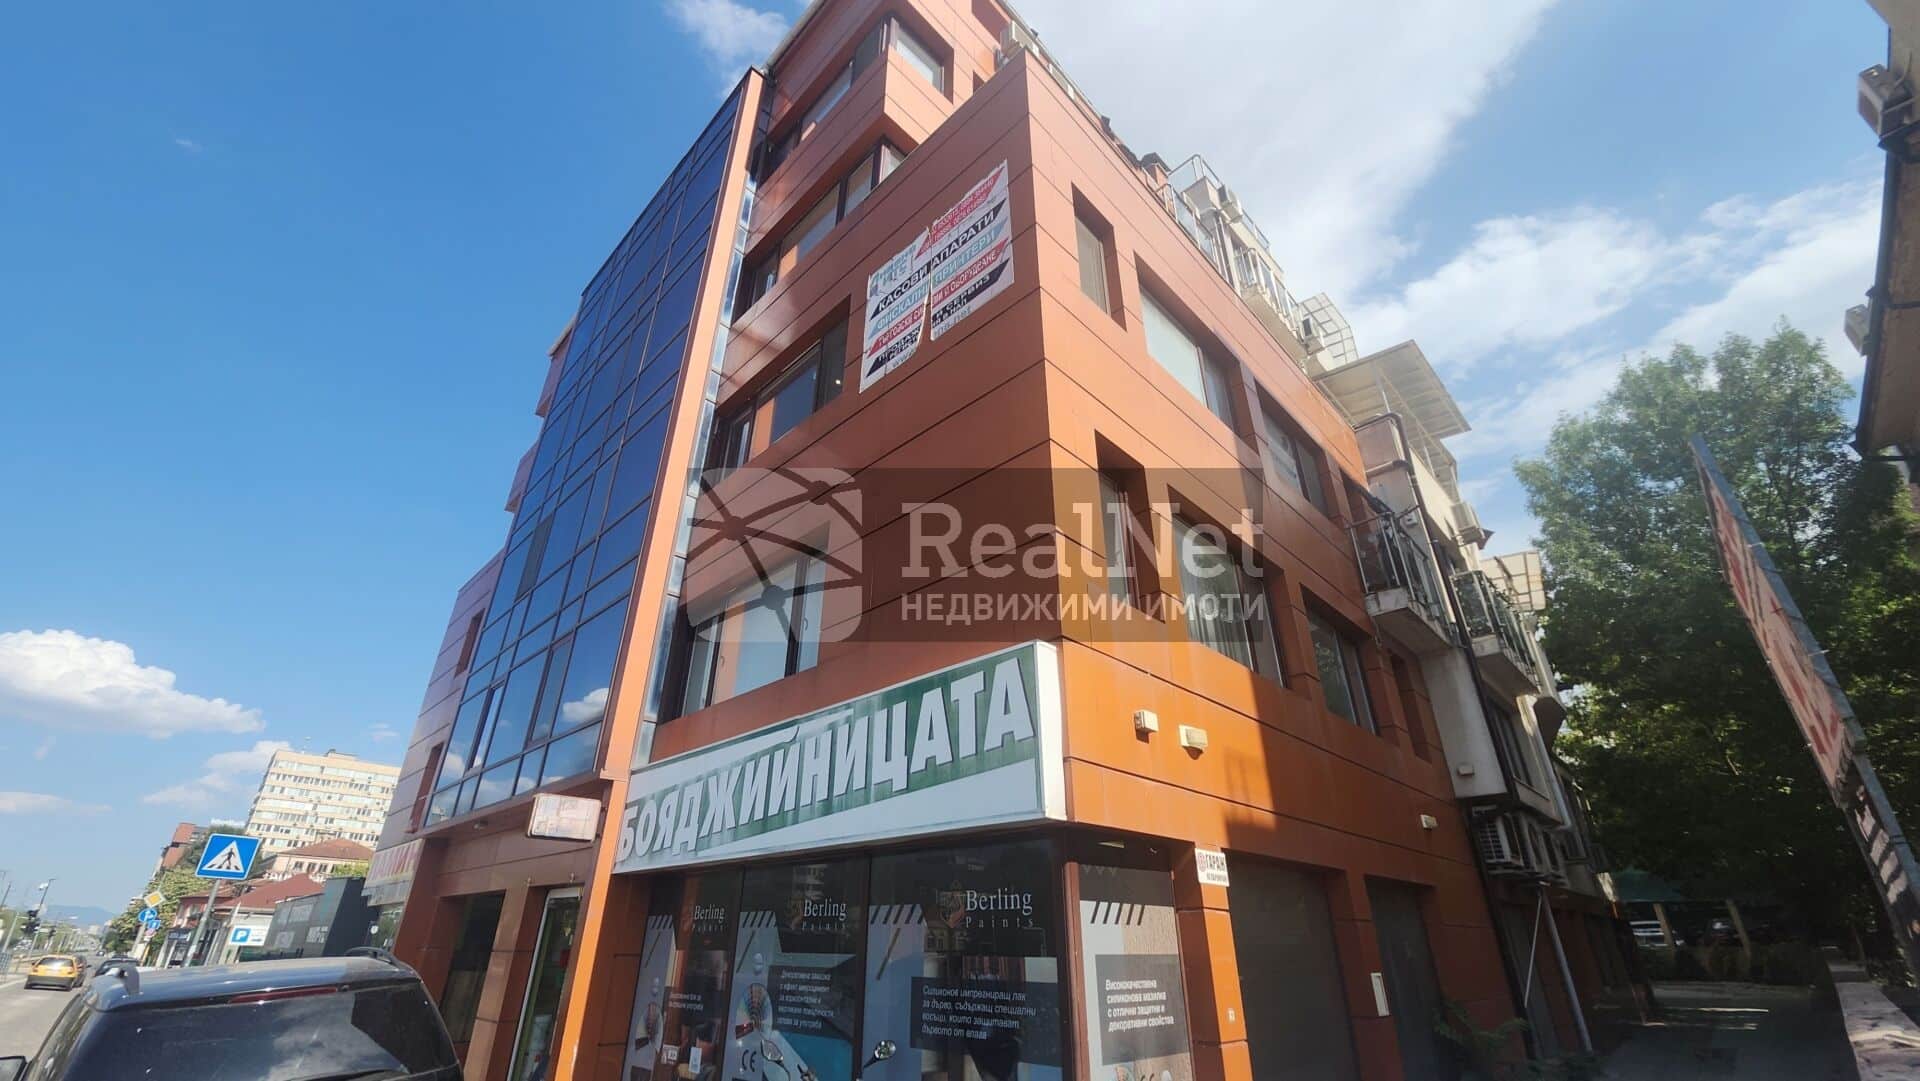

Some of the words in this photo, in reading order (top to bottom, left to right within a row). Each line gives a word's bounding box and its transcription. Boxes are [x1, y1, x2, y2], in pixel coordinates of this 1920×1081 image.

[879, 266, 928, 311] КАСОВИ
[931, 210, 994, 265] АПАРАТИ
[935, 229, 995, 284] ПРИНТЕРИ
[617, 656, 1035, 863] БОЯДЖИЙНИЦАТА
[803, 898, 847, 922] Berling
[965, 888, 1033, 916] Berling
[693, 904, 725, 923] Berling
[965, 916, 1035, 929] Paints
[922, 985, 959, 997] Силиконов
[960, 988, 1011, 1001] импрегниращ
[1012, 992, 1026, 1001] лак
[955, 1001, 993, 1013] съдържащ
[994, 1005, 1037, 1016] специални
[921, 1023, 952, 1036] дървото
[953, 1028, 965, 1037] от
[948, 1014, 972, 1024] които
[973, 1016, 1020, 1029] защитават
